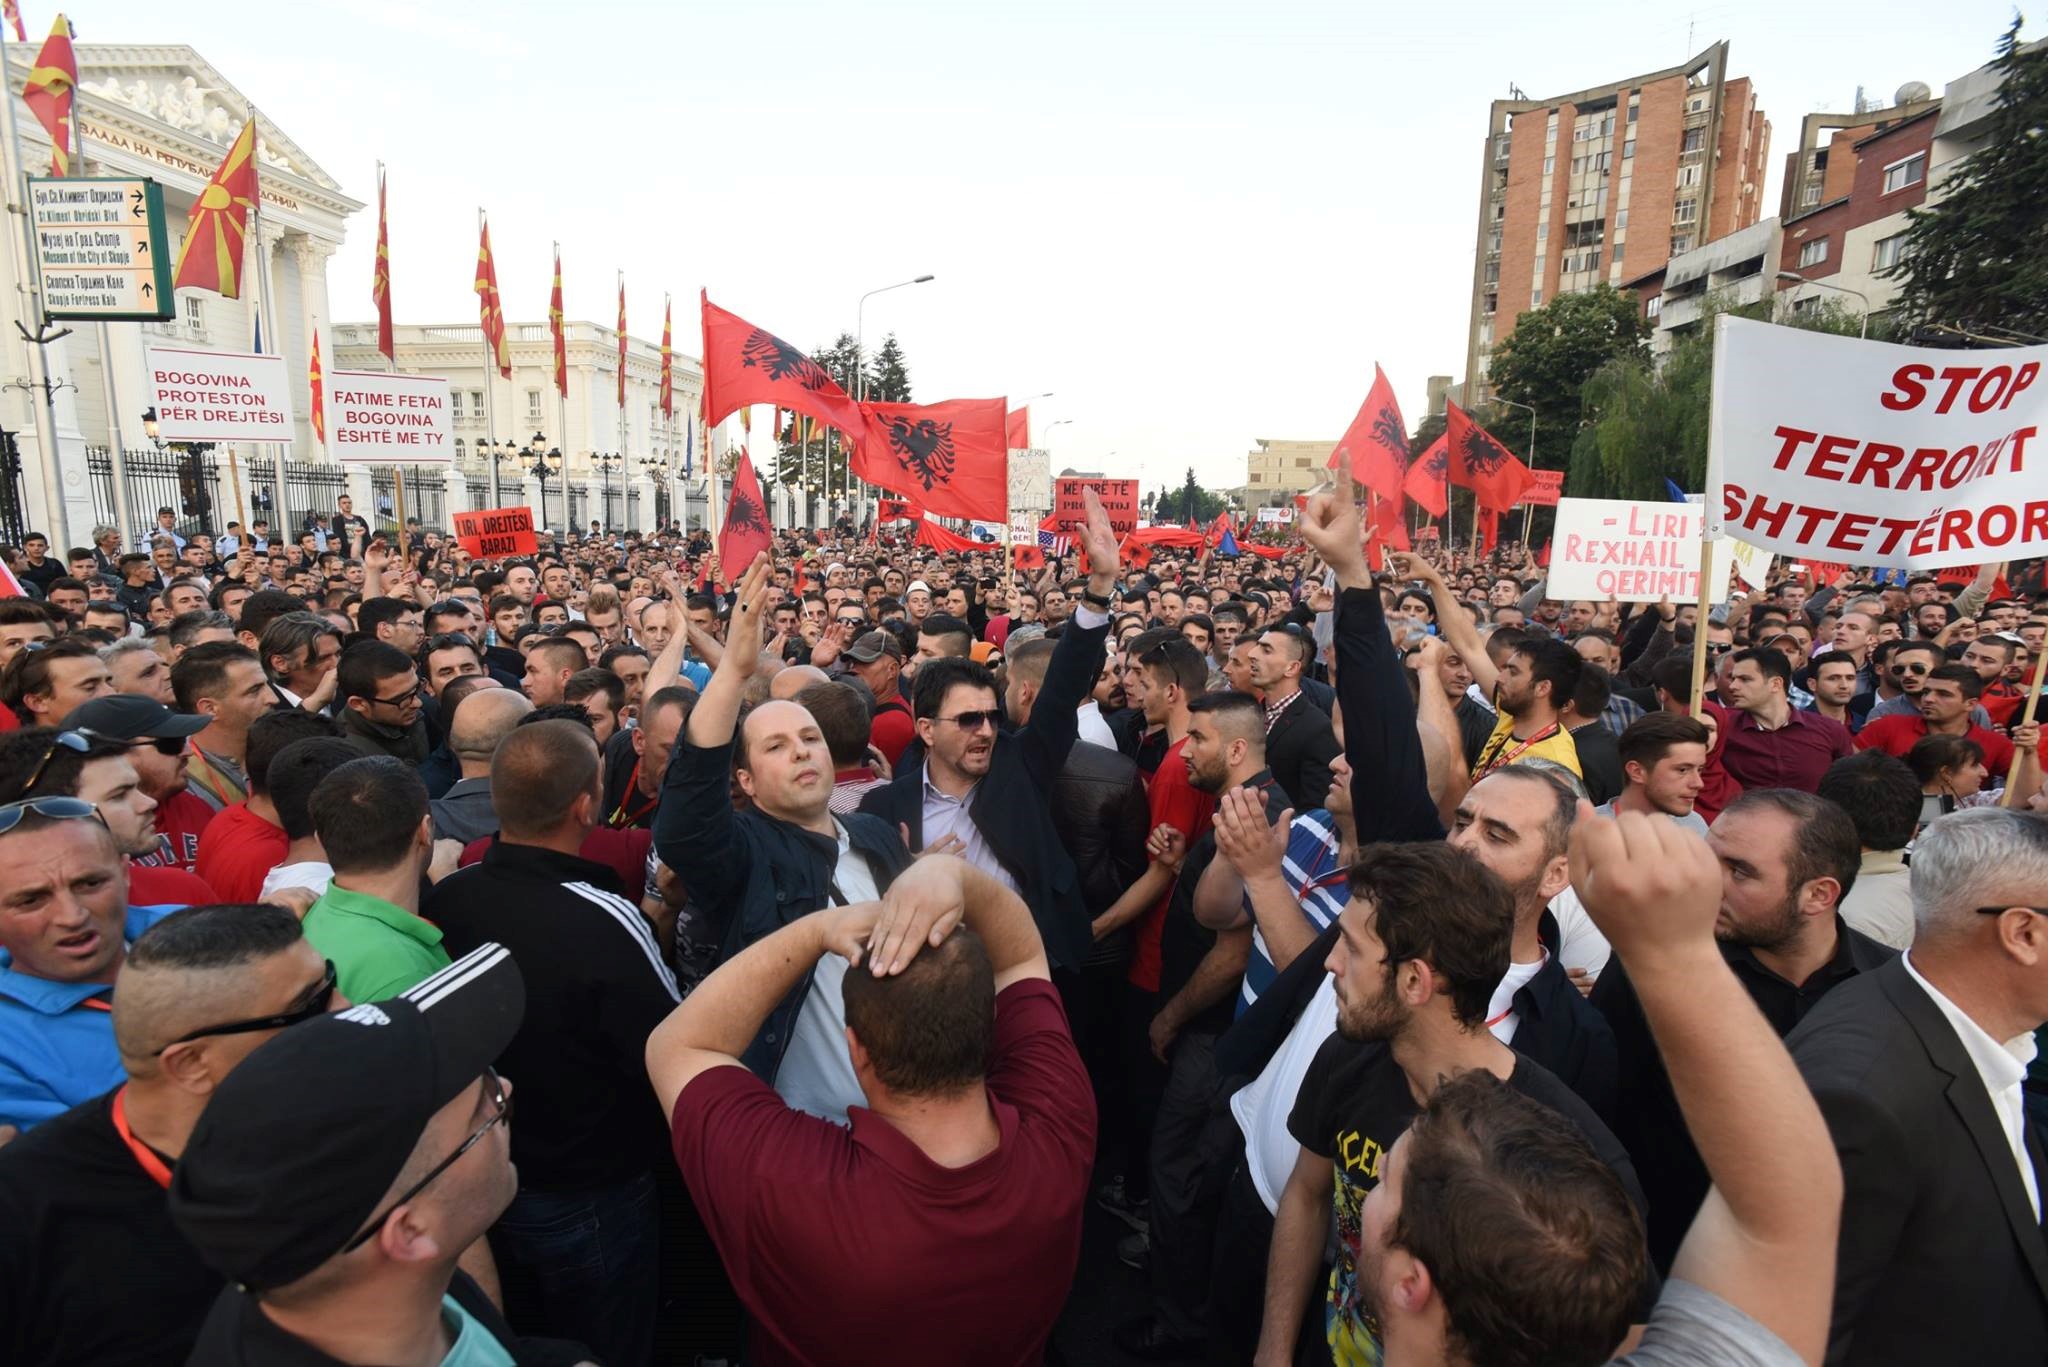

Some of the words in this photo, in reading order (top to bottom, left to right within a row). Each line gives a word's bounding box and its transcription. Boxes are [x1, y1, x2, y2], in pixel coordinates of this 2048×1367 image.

[79, 122, 130, 149] ВЛАДА
[134, 142, 153, 158] НА
[157, 151, 215, 179] РЕПУБЛИ
[260, 190, 299, 210] ДОНИЈА
[64, 234, 75, 248] на
[95, 231, 121, 249] Скопје
[70, 250, 77, 264] of
[77, 250, 87, 264] the
[87, 250, 100, 266] City
[109, 250, 130, 266] Skopje
[154, 371, 251, 388] BOGOVINA
[1880, 361, 2042, 415] STOP
[157, 389, 266, 407] PROTESTON
[334, 390, 394, 408] FATIME
[398, 394, 443, 409] FETAI
[160, 406, 199, 422] PËR
[202, 407, 286, 424] DREJTËSI
[345, 411, 434, 427] BOGOVINA
[336, 427, 393, 444] ËSHTË
[396, 431, 420, 445] ME
[424, 433, 444, 445] TY
[1772, 424, 2038, 492] TERRORIT
[1063, 480, 1078, 495] MË
[1081, 480, 1108, 495] IRË
[1112, 480, 1129, 495] TË
[1063, 501, 1130, 510] PROSTOJ
[1628, 505, 1688, 539] LIRI
[1722, 483, 2048, 557] SHTETËROR
[480, 535, 517, 557] BARAZI
[1565, 533, 1685, 569] REXHAIL
